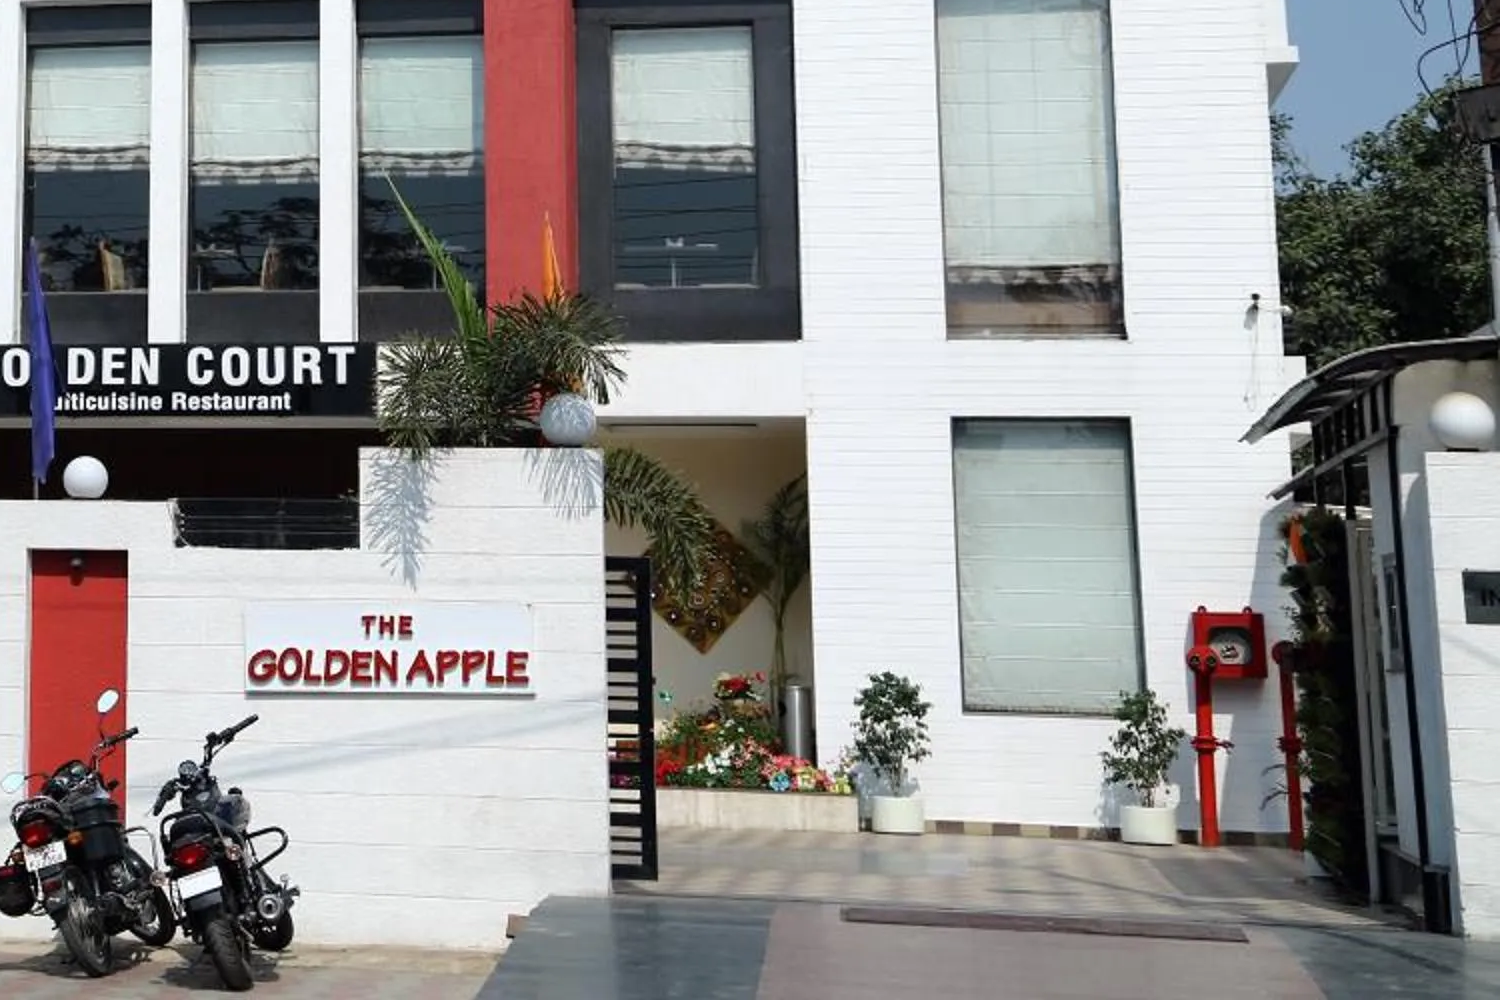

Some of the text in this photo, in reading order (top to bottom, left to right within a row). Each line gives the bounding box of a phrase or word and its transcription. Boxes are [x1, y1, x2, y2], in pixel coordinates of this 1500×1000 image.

[187, 346, 357, 387] COURT
[53, 391, 292, 412] ulticuisine Restaurant
[361, 615, 414, 640] THE
[248, 648, 530, 687] GOLDEN APPLE
